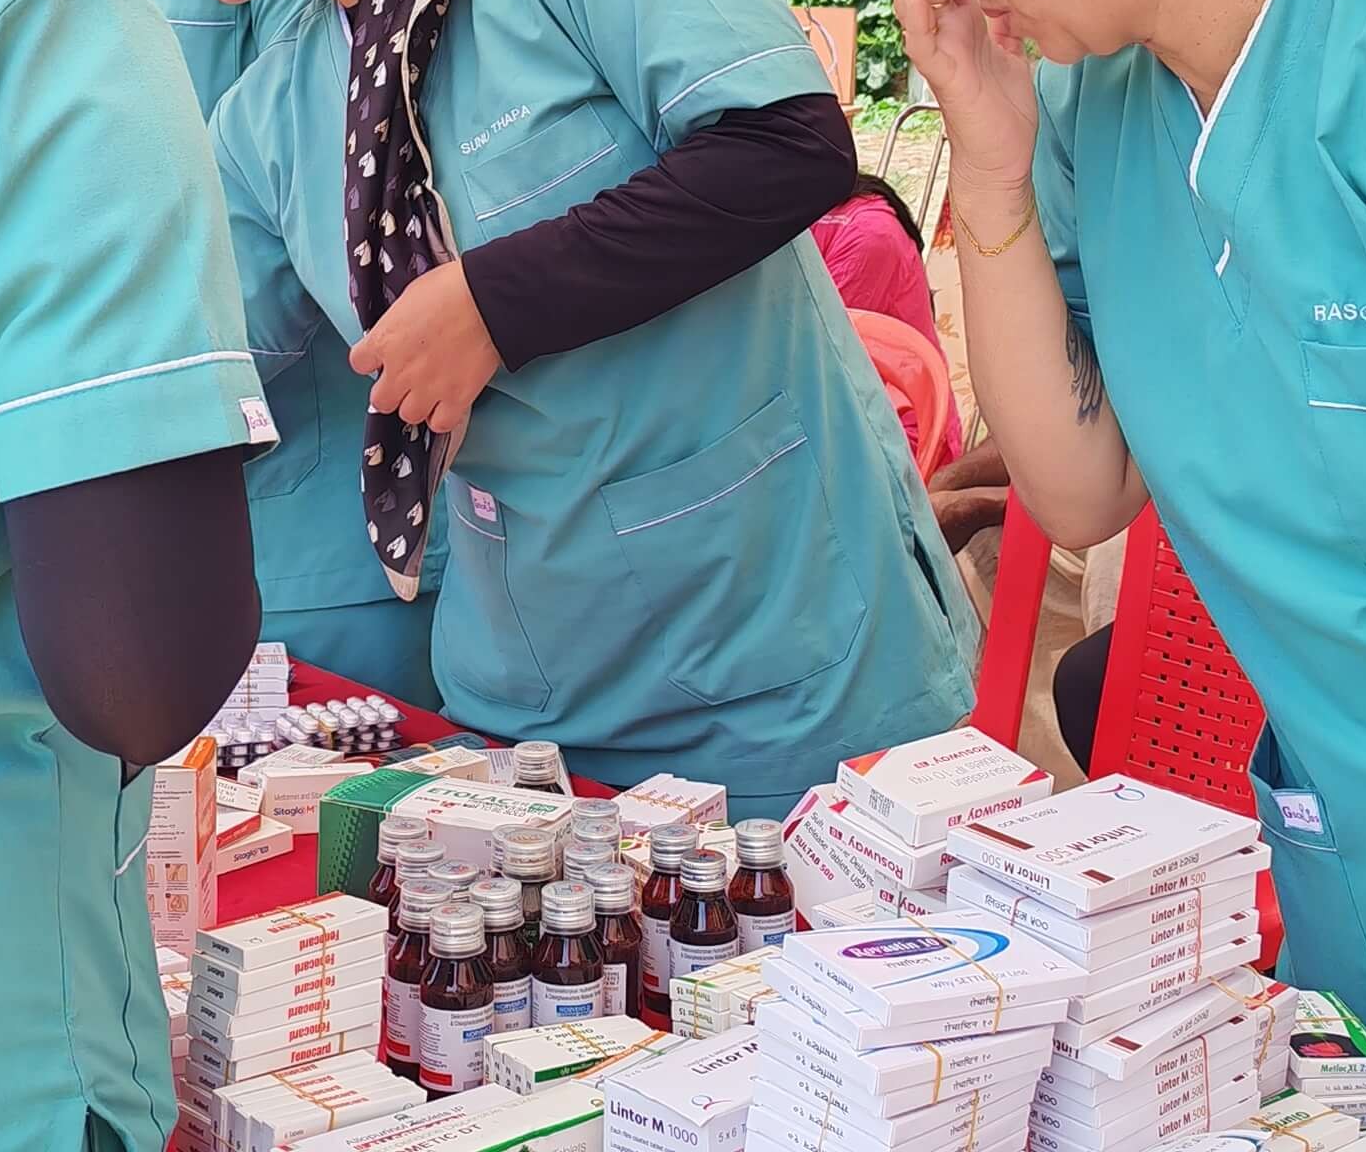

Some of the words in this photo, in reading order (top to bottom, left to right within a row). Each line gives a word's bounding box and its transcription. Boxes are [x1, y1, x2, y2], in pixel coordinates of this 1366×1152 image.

[490, 104, 531, 134] THAPA
[933, 744, 993, 764] Rosuway
[967, 796, 1023, 822] Rosuway
[1066, 836, 1092, 852] M
[1091, 824, 1142, 846] Lintor
[794, 833, 822, 866] SULTAB
[847, 835, 904, 881] Rosuway
[982, 852, 1002, 866] 500
[1036, 848, 1064, 863] 500
[1003, 860, 1019, 875] M
[1021, 866, 1050, 890] Lintor
[1149, 878, 1178, 896] Lintor
[1178, 876, 1188, 888] M
[1190, 871, 1207, 885] 500
[1150, 906, 1176, 925] Lintor
[1176, 903, 1186, 915] M
[918, 937, 940, 947] 10
[1150, 926, 1176, 945] Lintor
[1175, 923, 1185, 935] M
[1150, 950, 1176, 969] Lintor
[1176, 946, 1186, 959] M
[1150, 974, 1176, 994] Lintor
[1176, 971, 1186, 984] M
[691, 1051, 744, 1075] Lintor
[1154, 1058, 1178, 1076] Lintor
[1179, 1054, 1189, 1066] M
[1189, 1046, 1204, 1061] 500
[1157, 1077, 1180, 1095] Lintor
[1180, 1072, 1190, 1084] M
[1190, 1063, 1205, 1078] 500
[1158, 1099, 1182, 1116] Lintor
[1181, 1094, 1191, 1106] M
[1191, 1083, 1205, 1099] 500
[610, 1099, 648, 1128] Lintor
[652, 1116, 665, 1135] M
[668, 1123, 699, 1147] 1000
[1158, 1120, 1182, 1138] Lintor
[1182, 1114, 1192, 1127] M
[1192, 1104, 1207, 1120] 500
